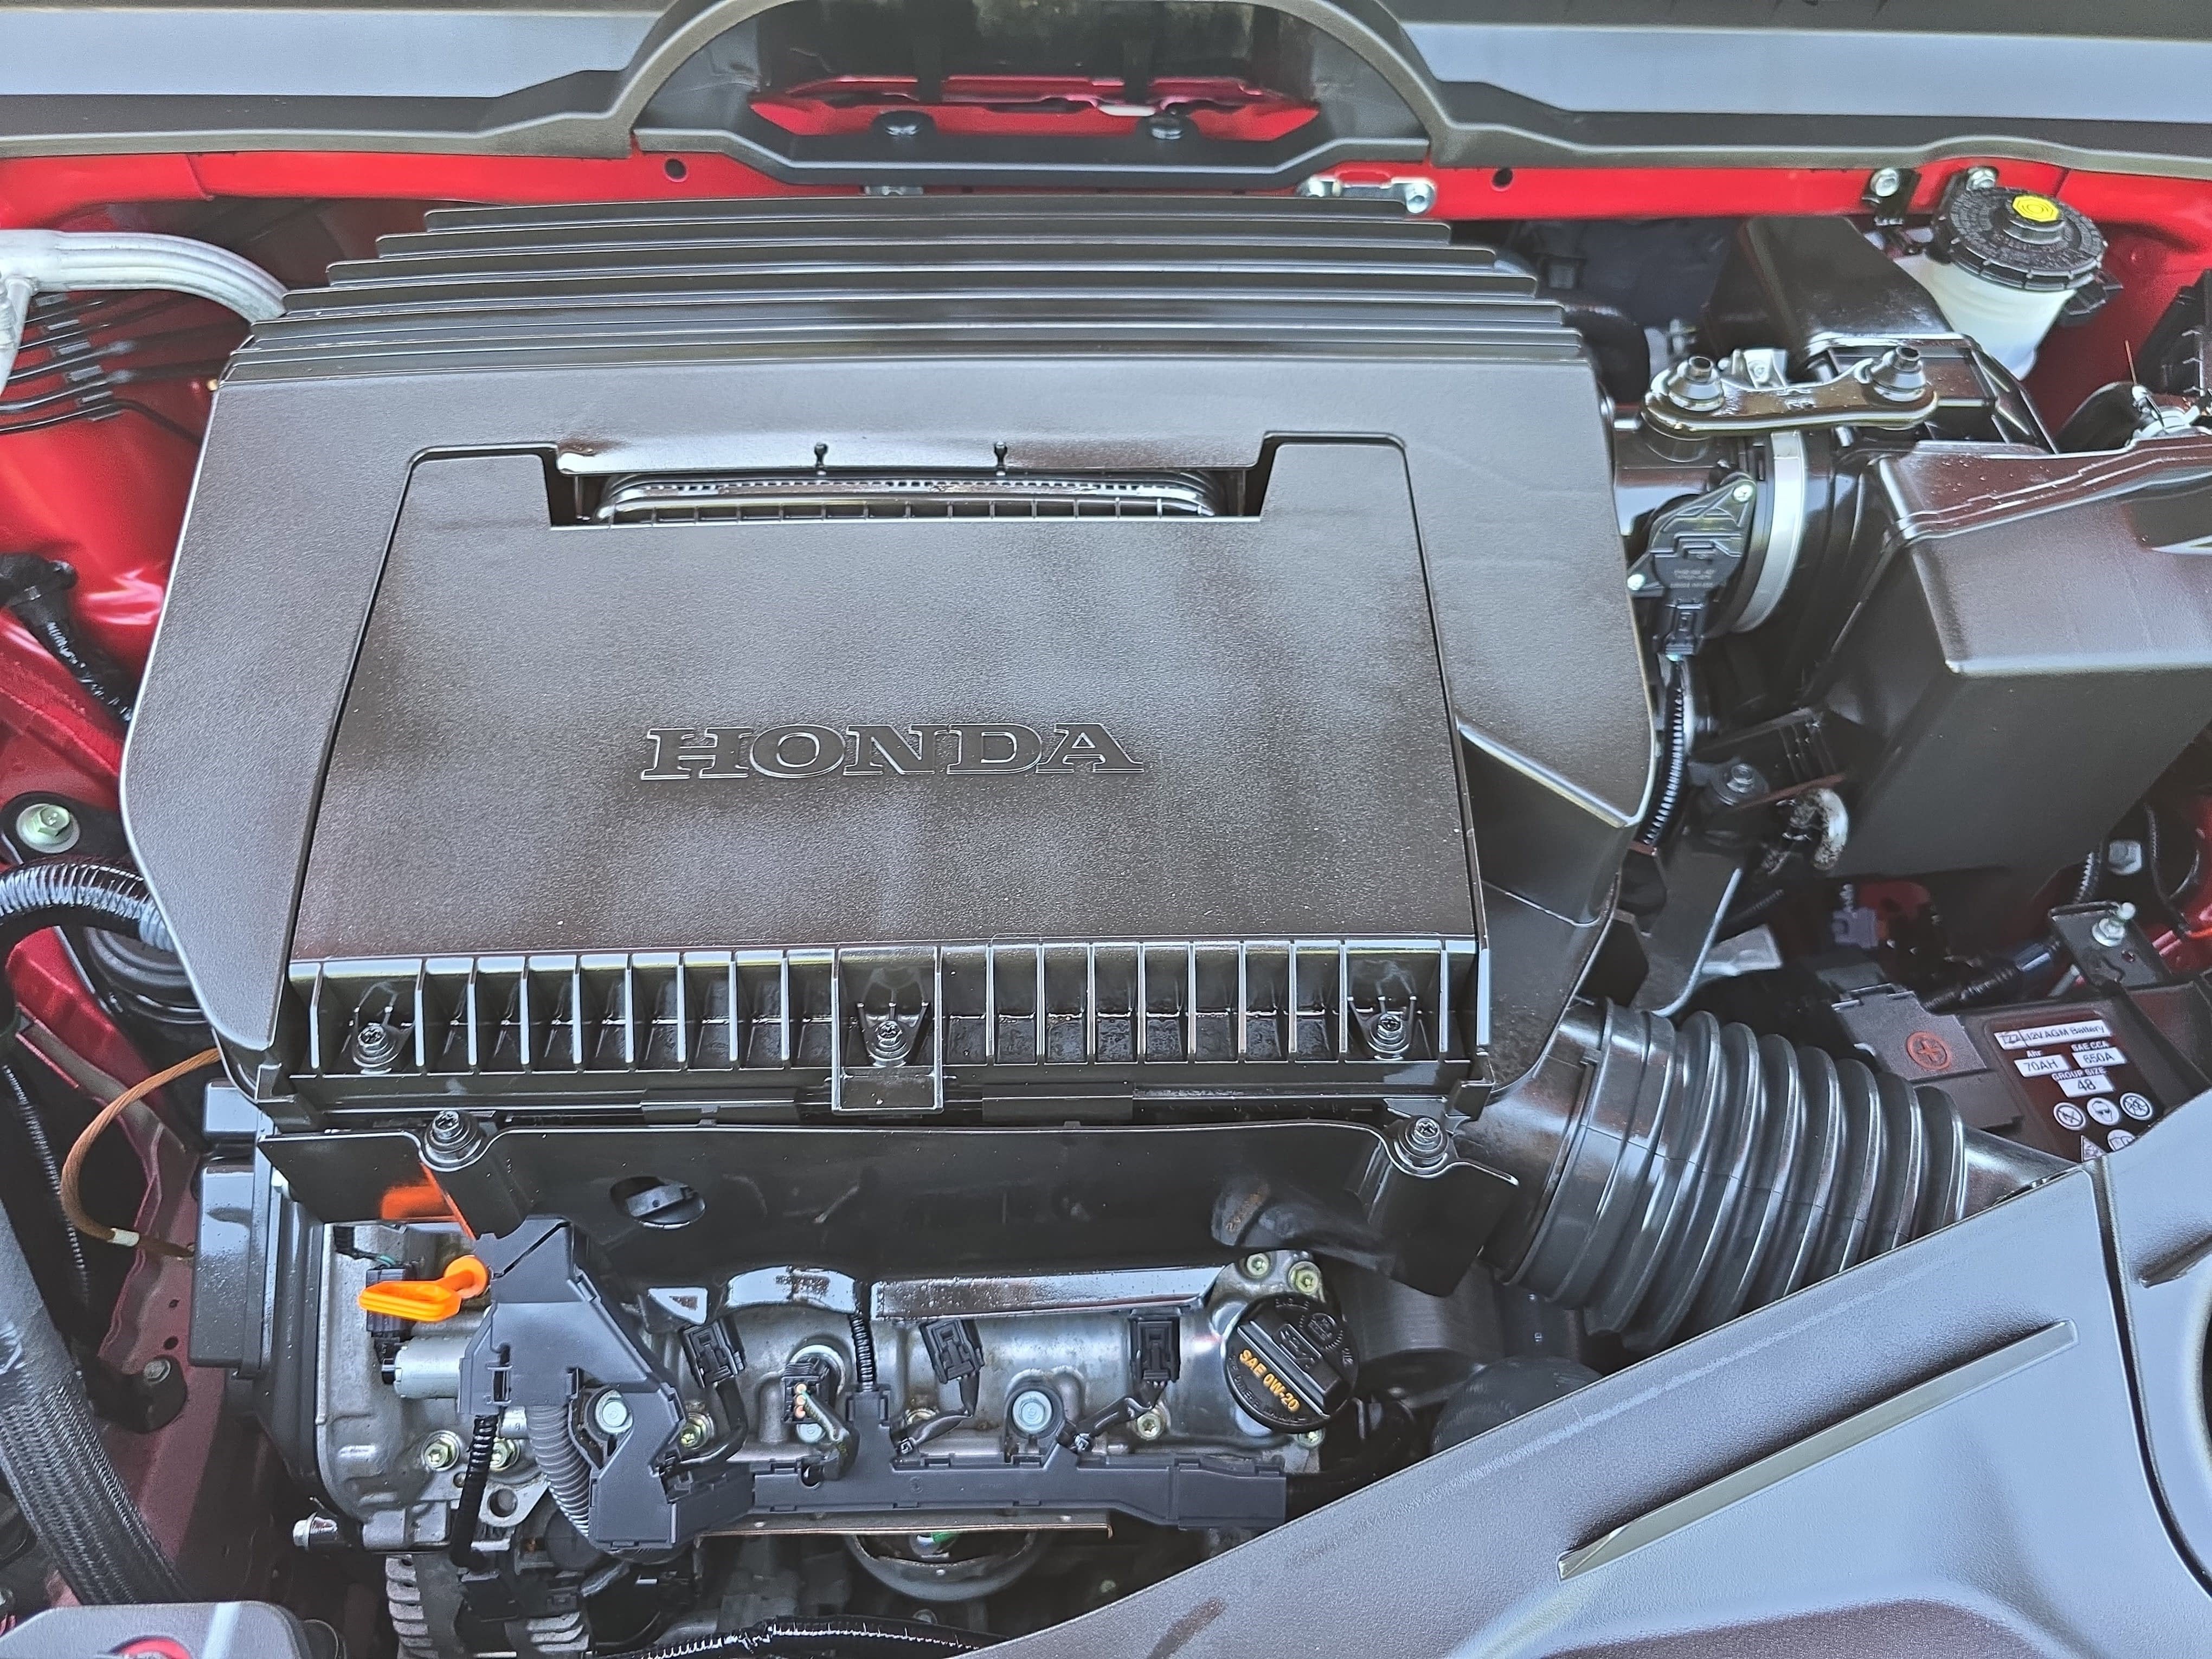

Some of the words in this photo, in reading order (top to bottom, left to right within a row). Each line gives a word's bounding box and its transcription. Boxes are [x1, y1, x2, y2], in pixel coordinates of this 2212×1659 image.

[641, 723, 1144, 781] HONDA
[2027, 1031, 2043, 1041] 12V
[2044, 1028, 2069, 1039] AGM
[2071, 1025, 2105, 1035] Battery
[2071, 1043, 2089, 1052] SAE
[2089, 1040, 2110, 1050] CCA
[2083, 1052, 2114, 1063] 650A
[2023, 1059, 2059, 1072] 70AH
[2052, 1069, 2084, 1081] GROUP
[2085, 1067, 2106, 1076] SIZE
[2077, 1079, 2097, 1091] 48
[1239, 1349, 1267, 1378] SAE
[1263, 1373, 1300, 1413] 0W-20
